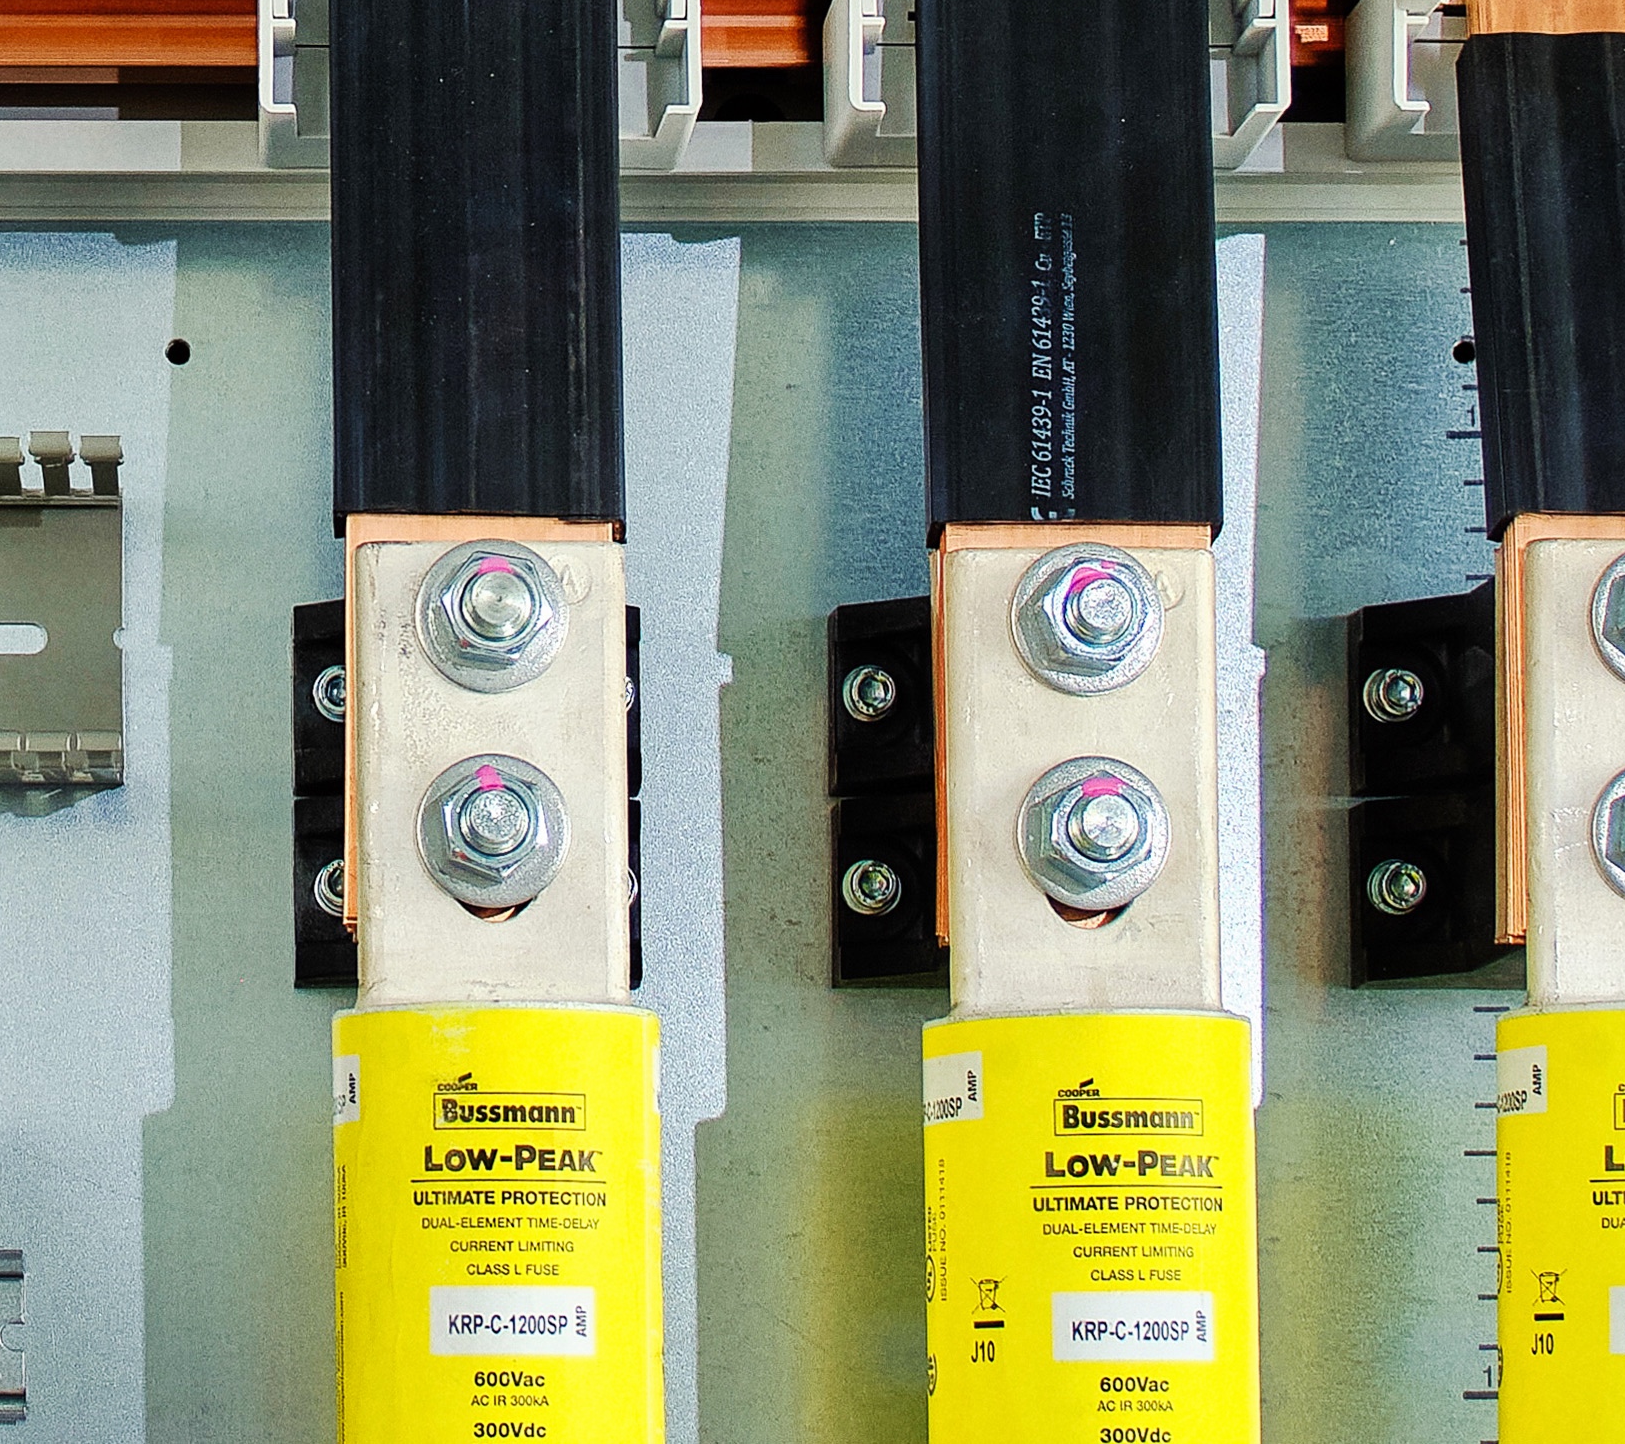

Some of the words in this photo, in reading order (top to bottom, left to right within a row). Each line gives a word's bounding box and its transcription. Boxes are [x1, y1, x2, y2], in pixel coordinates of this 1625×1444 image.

[1061, 323, 1076, 351] 1230
[1031, 352, 1052, 381] EN
[1031, 388, 1052, 461] 61439-1
[1061, 411, 1076, 453] Technik
[1031, 466, 1052, 498] IEC
[1061, 455, 1076, 499] Schrack
[438, 1081, 477, 1091] COOPER
[967, 1070, 978, 1102] AMP
[1532, 1063, 1542, 1095] AMP
[347, 1072, 357, 1104] AMP
[1057, 1088, 1100, 1098] COOPER
[413, 1190, 495, 1207] ULTIMATE
[500, 1190, 607, 1207] PROTECTION
[1032, 1197, 1119, 1213] ULTIMATE
[1125, 1197, 1223, 1213] PROTECTION
[421, 1216, 523, 1230] DUAL-ELEMENT
[527, 1216, 599, 1230] TIME-DELAY
[1043, 1222, 1146, 1236] DUAL-ELEMENT
[1149, 1222, 1217, 1236] TIME-DELAY
[450, 1240, 514, 1253] CURRENT
[518, 1240, 575, 1253] LIMITING
[1073, 1246, 1138, 1259] CURRENT
[1141, 1246, 1194, 1259] LIMITING
[466, 1263, 511, 1276] CLASS
[515, 1263, 521, 1276] L
[525, 1263, 559, 1276] FUSE
[1090, 1269, 1134, 1282] CLASS
[1138, 1269, 1145, 1282] L
[1149, 1269, 1182, 1282] FUSE
[448, 1314, 568, 1336] KRP-C-1200SP
[575, 1305, 588, 1338] AMP
[1071, 1319, 1190, 1341] KRP-C-1200SP
[1196, 1309, 1208, 1342] AMP
[971, 1340, 996, 1363] J10
[1530, 1332, 1555, 1356] J10
[473, 1371, 545, 1388] 600Vac
[1099, 1377, 1170, 1393] 600Vac
[471, 1394, 490, 1407] AC
[493, 1394, 507, 1407] IR
[511, 1394, 549, 1407] 300kA
[1097, 1400, 1116, 1412] AC
[1119, 1400, 1132, 1412] IR
[1136, 1400, 1173, 1412] 300kA
[473, 1422, 546, 1439] 300Vdc
[1099, 1428, 1171, 1444] 300Vdc
